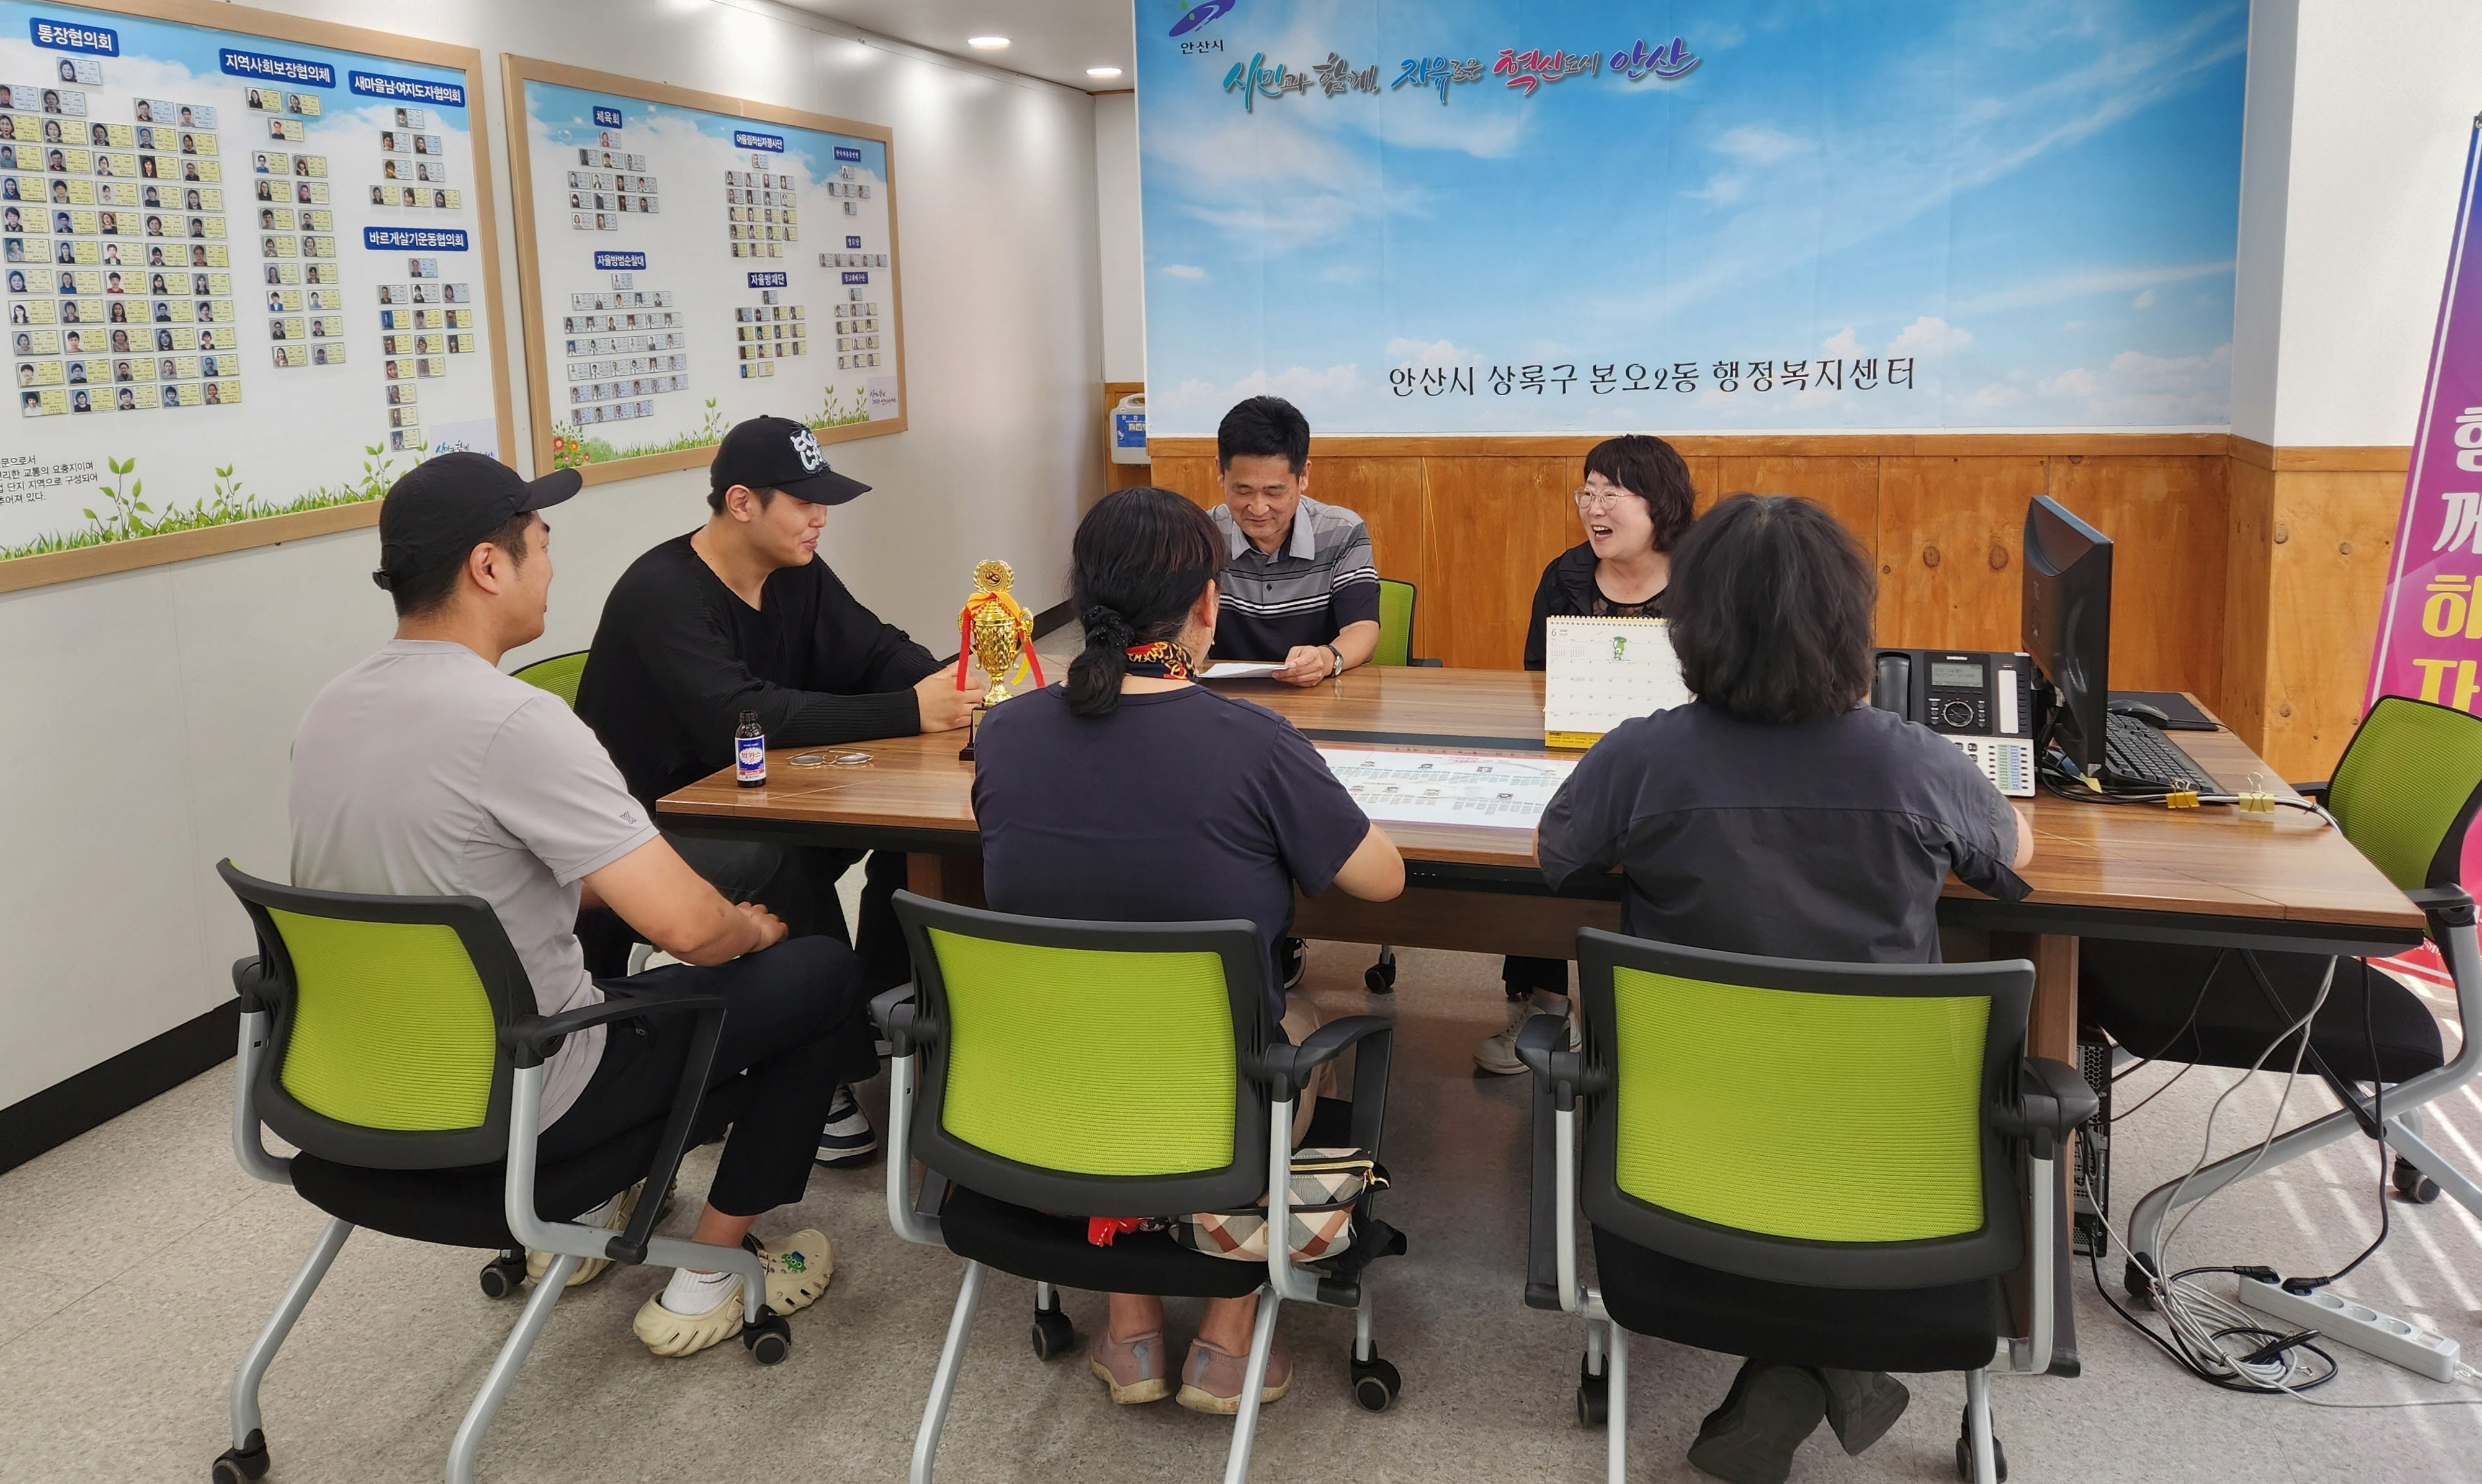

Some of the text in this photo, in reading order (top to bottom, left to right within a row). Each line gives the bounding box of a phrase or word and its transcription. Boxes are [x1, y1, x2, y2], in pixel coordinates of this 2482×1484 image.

[37, 24, 113, 51] 통장협의회
[1180, 38, 1224, 55] 안산시
[225, 53, 331, 83] 지역사회보장협의체
[1222, 51, 1311, 112] 시민과
[1390, 55, 1484, 104] 자유로운
[1492, 48, 1600, 96] 혁신도시
[1608, 35, 1700, 81] 안산
[596, 110, 620, 126] 체육회
[736, 133, 782, 150] 어울림적십자봉사단
[369, 231, 464, 248] 바르게살기운동협의회
[596, 253, 645, 268] 자율방범순찰대
[750, 273, 784, 287] 자율방재단
[1388, 357, 1915, 398] 안산시 상록구 본오2동 행정복지센터
[0, 454, 36, 468] 문으로서
[24, 466, 49, 478] 교통의
[52, 461, 94, 474] 요충지이며
[7, 481, 25, 493] 단지
[28, 477, 63, 489] 지역으로
[65, 472, 98, 486] 구성되어
[26, 491, 47, 503] 있다.
[1551, 628, 1557, 637] 6
